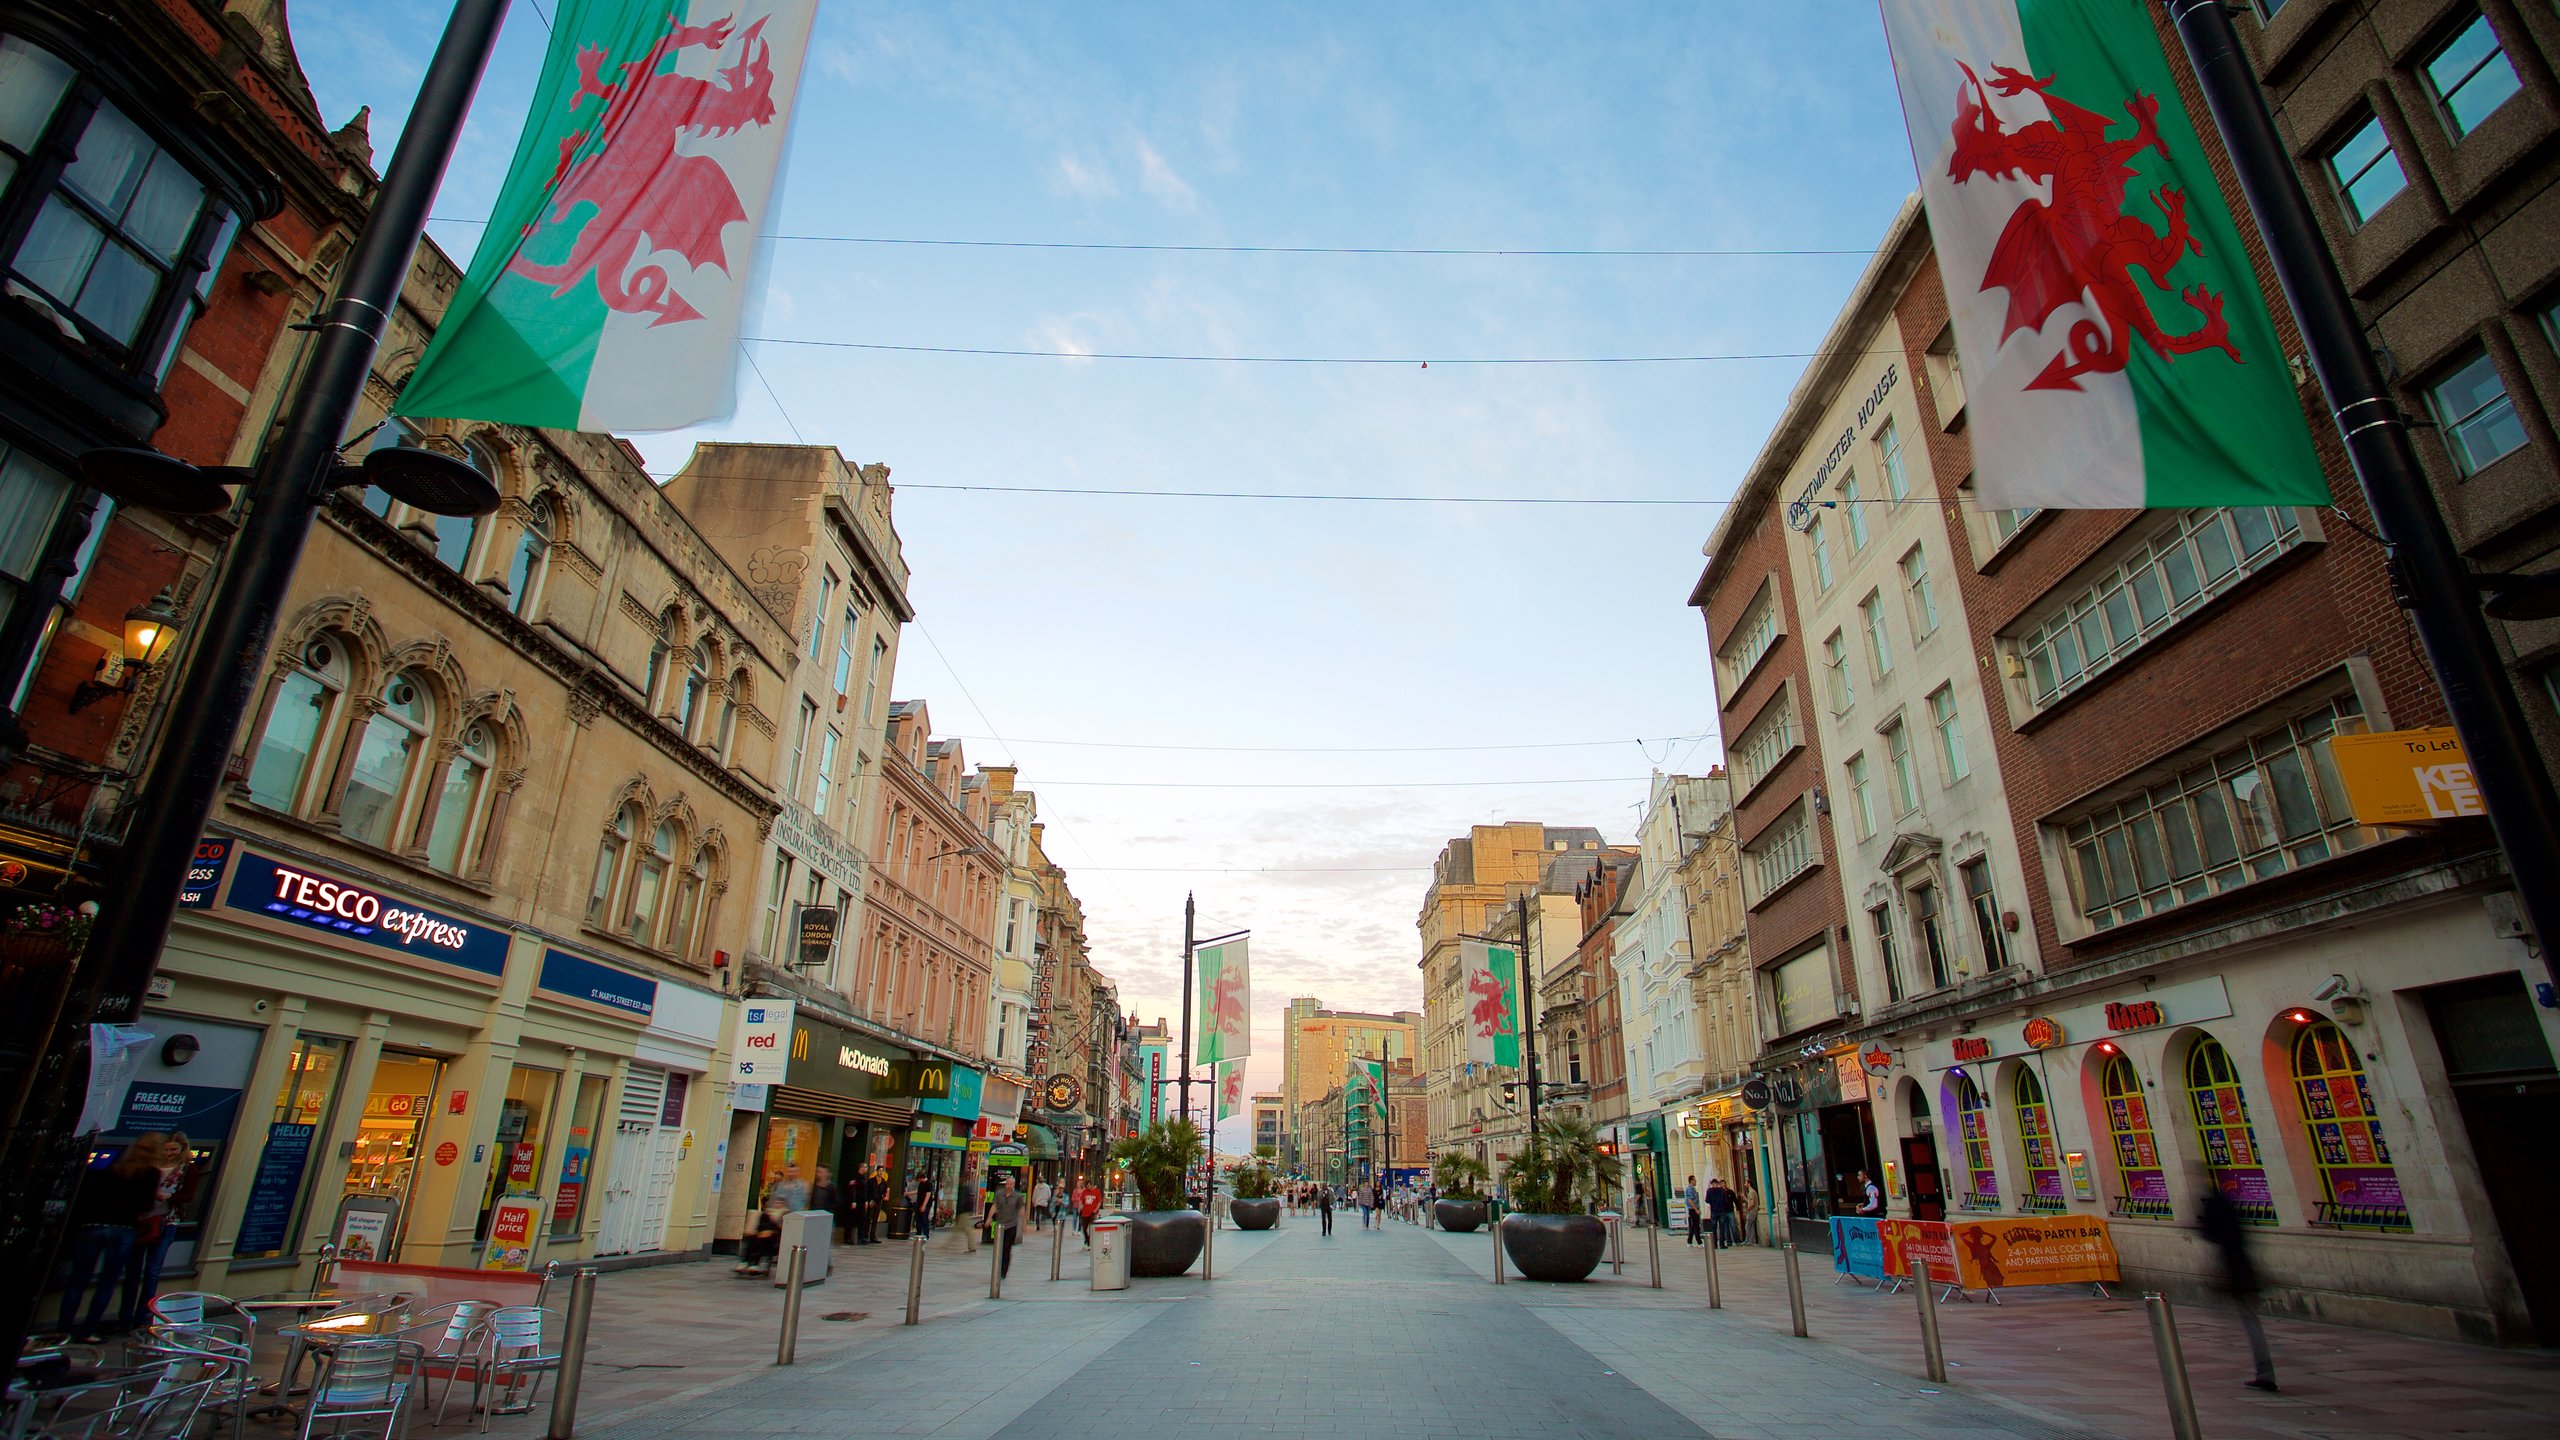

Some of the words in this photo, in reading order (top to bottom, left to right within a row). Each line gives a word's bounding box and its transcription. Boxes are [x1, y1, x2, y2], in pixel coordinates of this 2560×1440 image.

[1790, 426, 1857, 525] WESTMINSTER
[1857, 363, 1898, 430] HOUSE
[2405, 743, 2426, 754] To
[2430, 739, 2458, 751] Let
[2413, 763, 2473, 793] KE
[2423, 788, 2484, 819] LE
[781, 799, 803, 830] ROYAL
[805, 818, 835, 853] LONDON
[836, 842, 862, 873] MUTUAL
[776, 818, 819, 862] INSURANCE
[820, 851, 849, 882] SOCIETY
[273, 867, 380, 923] TESCO
[382, 907, 468, 950] express
[801, 931, 832, 939] LONDON
[598, 991, 617, 1003] MARY'S
[616, 995, 633, 1008] STREET
[749, 1011, 764, 1022] tsr
[766, 1009, 788, 1021] legal
[1033, 951, 1055, 1108] RESTAURANT
[747, 1033, 776, 1048] red
[839, 1045, 890, 1078] McDonald's
[1745, 1089, 1769, 1100] No.1
[1773, 1077, 1796, 1104] No.1
[134, 1092, 159, 1103] FREE
[159, 1093, 186, 1105] CASH
[130, 1102, 183, 1114] WITHDRAWALS
[391, 1100, 408, 1111] GO
[274, 1125, 311, 1138] HELLO
[272, 1140, 298, 1148] WELCOME
[298, 1140, 307, 1148] TO
[516, 1150, 533, 1162] Half
[512, 1163, 531, 1175] price
[502, 1212, 526, 1223] Half
[497, 1222, 524, 1234] price
[2044, 1228, 2077, 1240] PARTY
[2080, 1227, 2102, 1238] BAR
[2007, 1248, 2027, 1257] 2-4-1
[2029, 1246, 2043, 1255] ON
[2044, 1245, 2058, 1255] ALL
[2005, 1258, 2024, 1267] AND
[2026, 1255, 2060, 1266] PARTINIS
[2060, 1254, 2085, 1264] EVERY
[2087, 1253, 2110, 1262] NIHT
